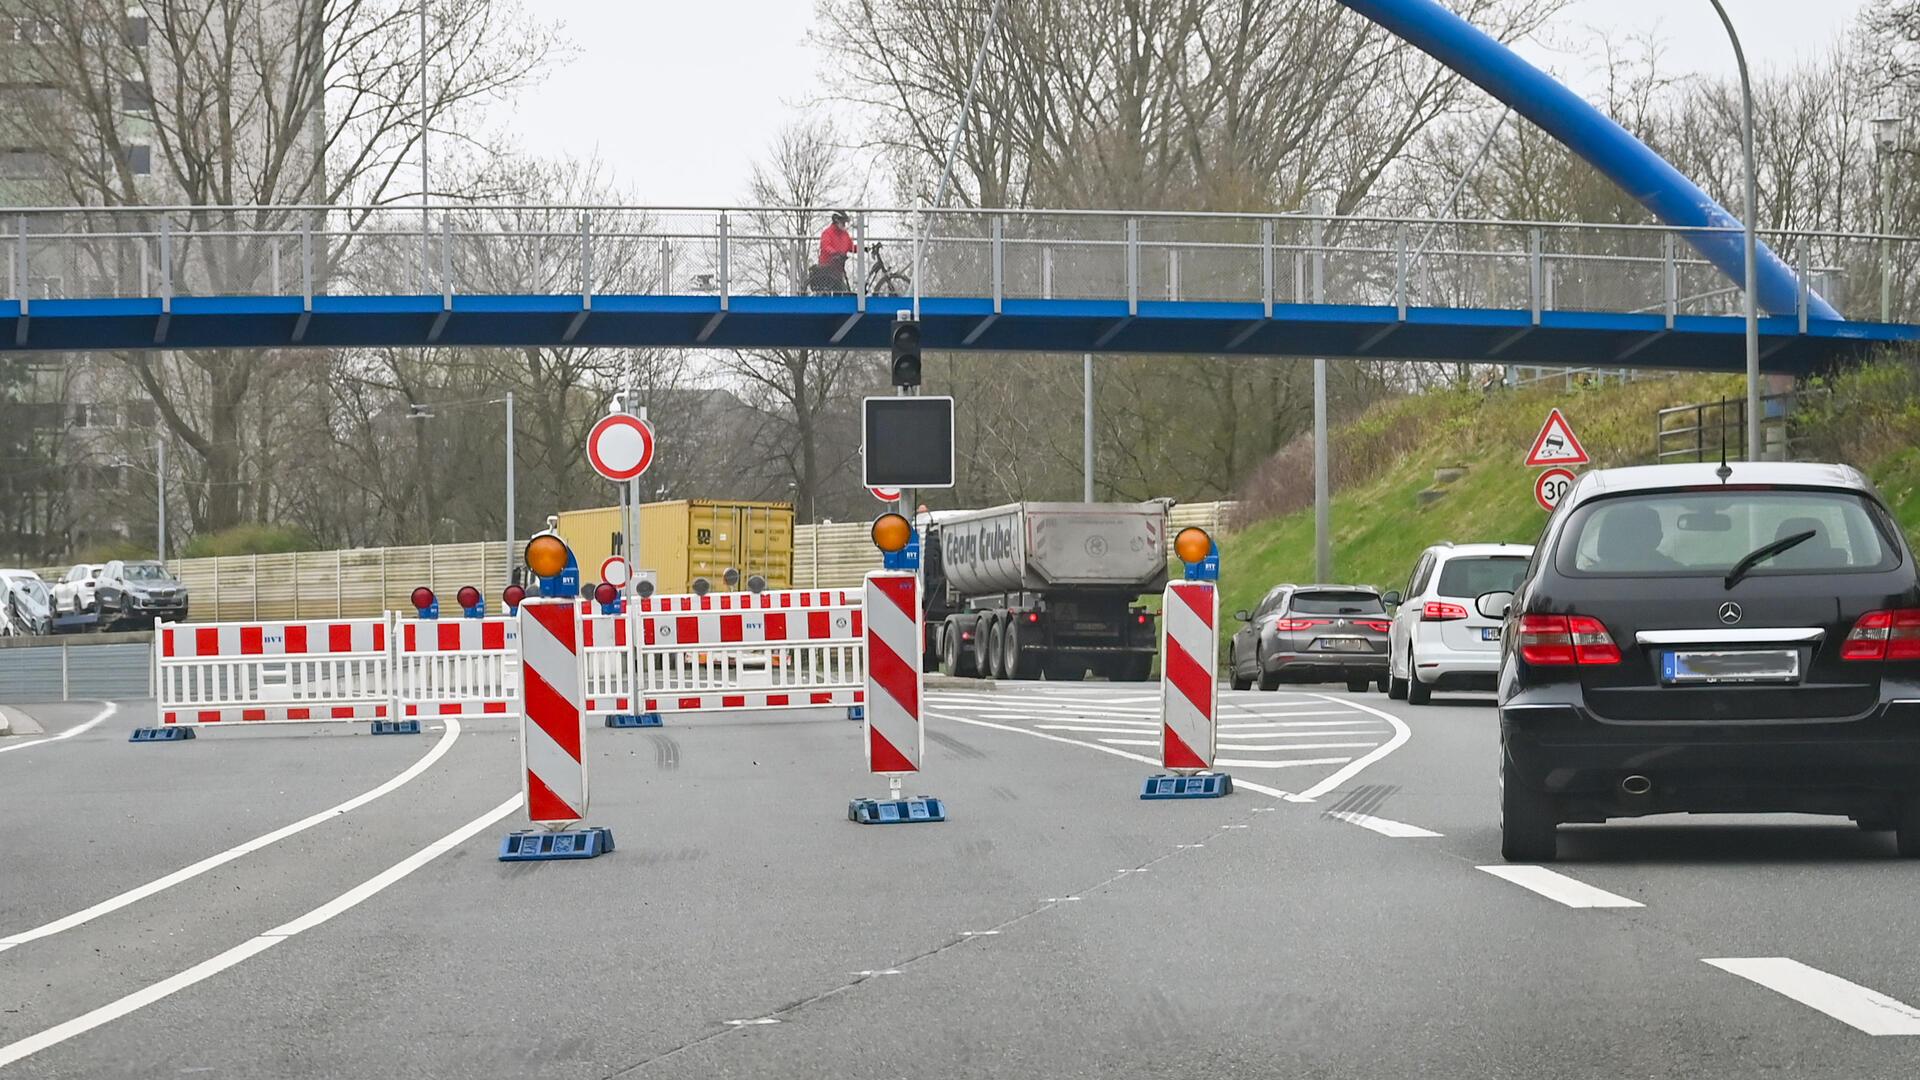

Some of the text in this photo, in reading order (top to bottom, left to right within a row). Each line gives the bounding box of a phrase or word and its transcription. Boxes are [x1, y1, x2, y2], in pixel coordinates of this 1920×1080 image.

[1544, 480, 1568, 500] 30
[946, 523, 1011, 568] Georg Grube
